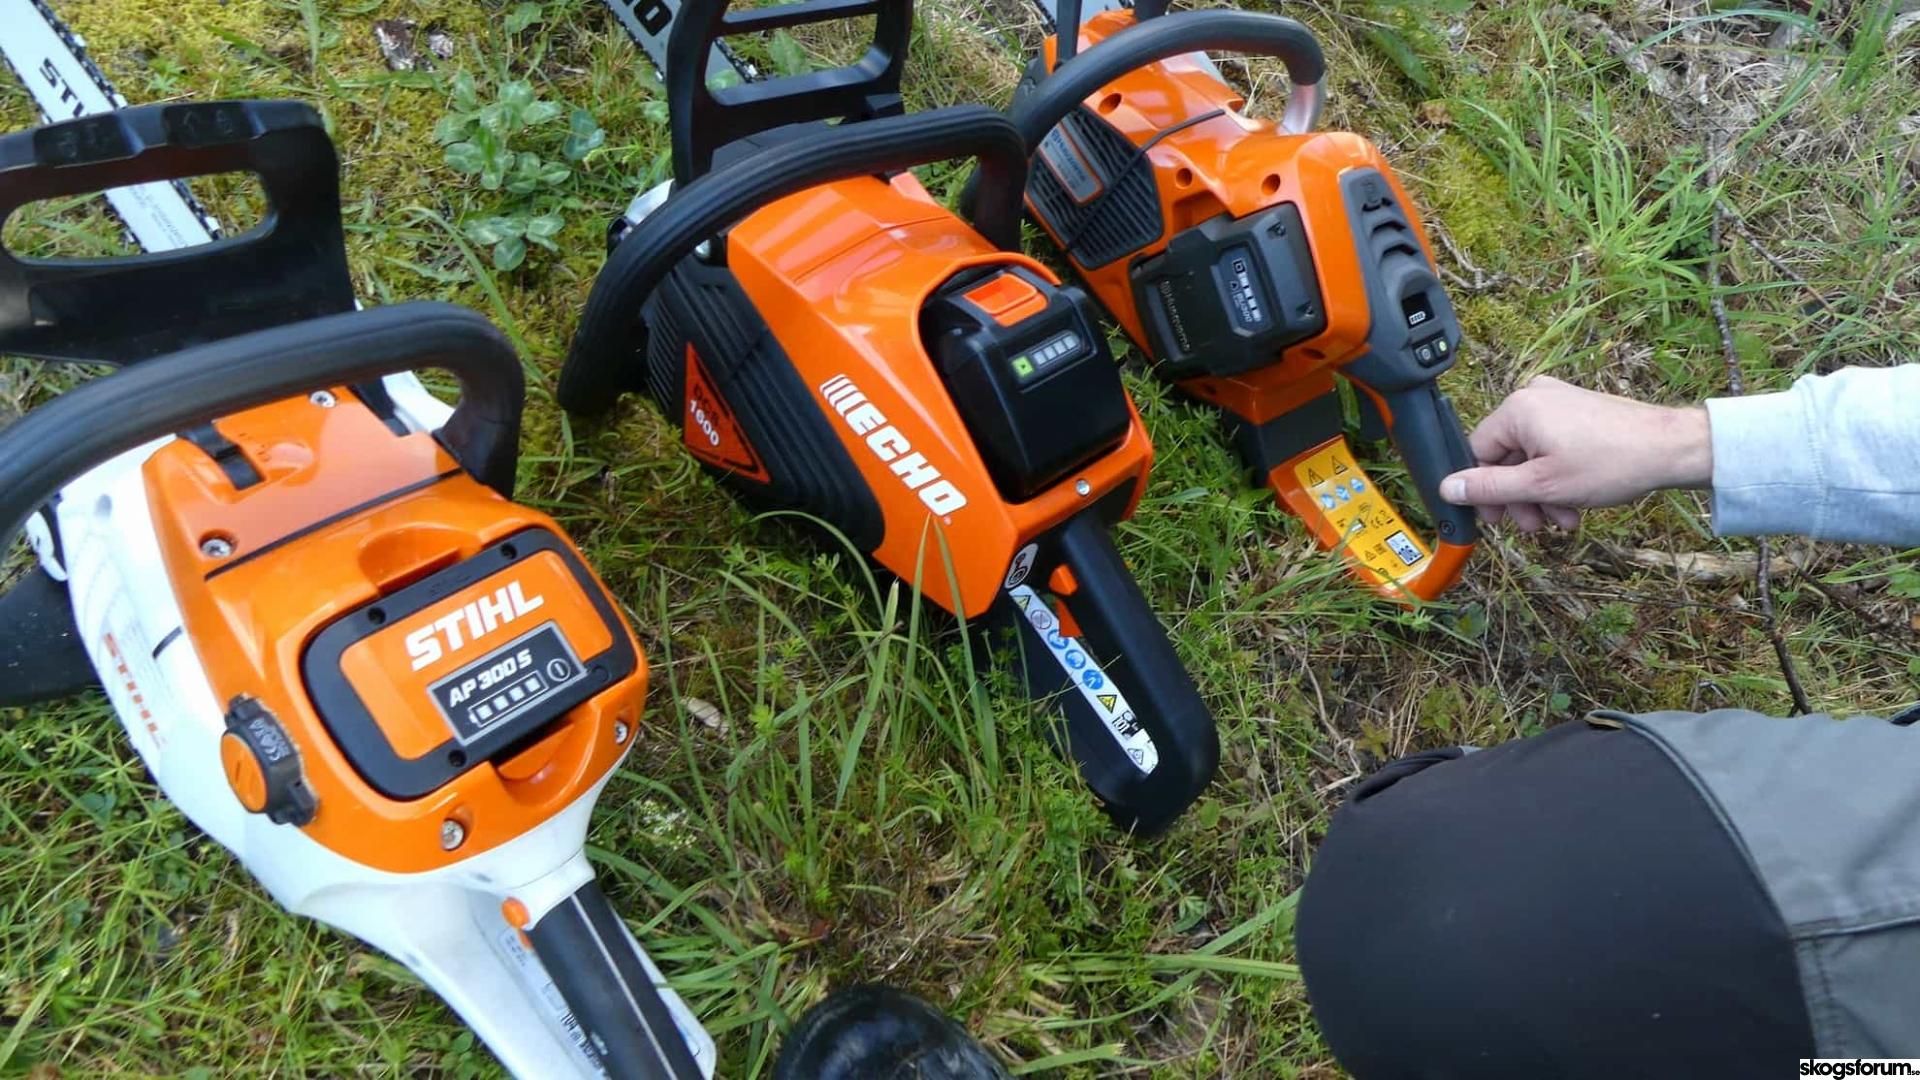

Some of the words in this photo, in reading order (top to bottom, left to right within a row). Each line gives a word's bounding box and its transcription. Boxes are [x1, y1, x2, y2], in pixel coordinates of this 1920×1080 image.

[39, 57, 90, 118] STI
[844, 402, 968, 517] ECHO
[406, 580, 545, 672] STIHL
[449, 678, 478, 708] AP
[477, 656, 518, 690] 300
[516, 648, 533, 670] S
